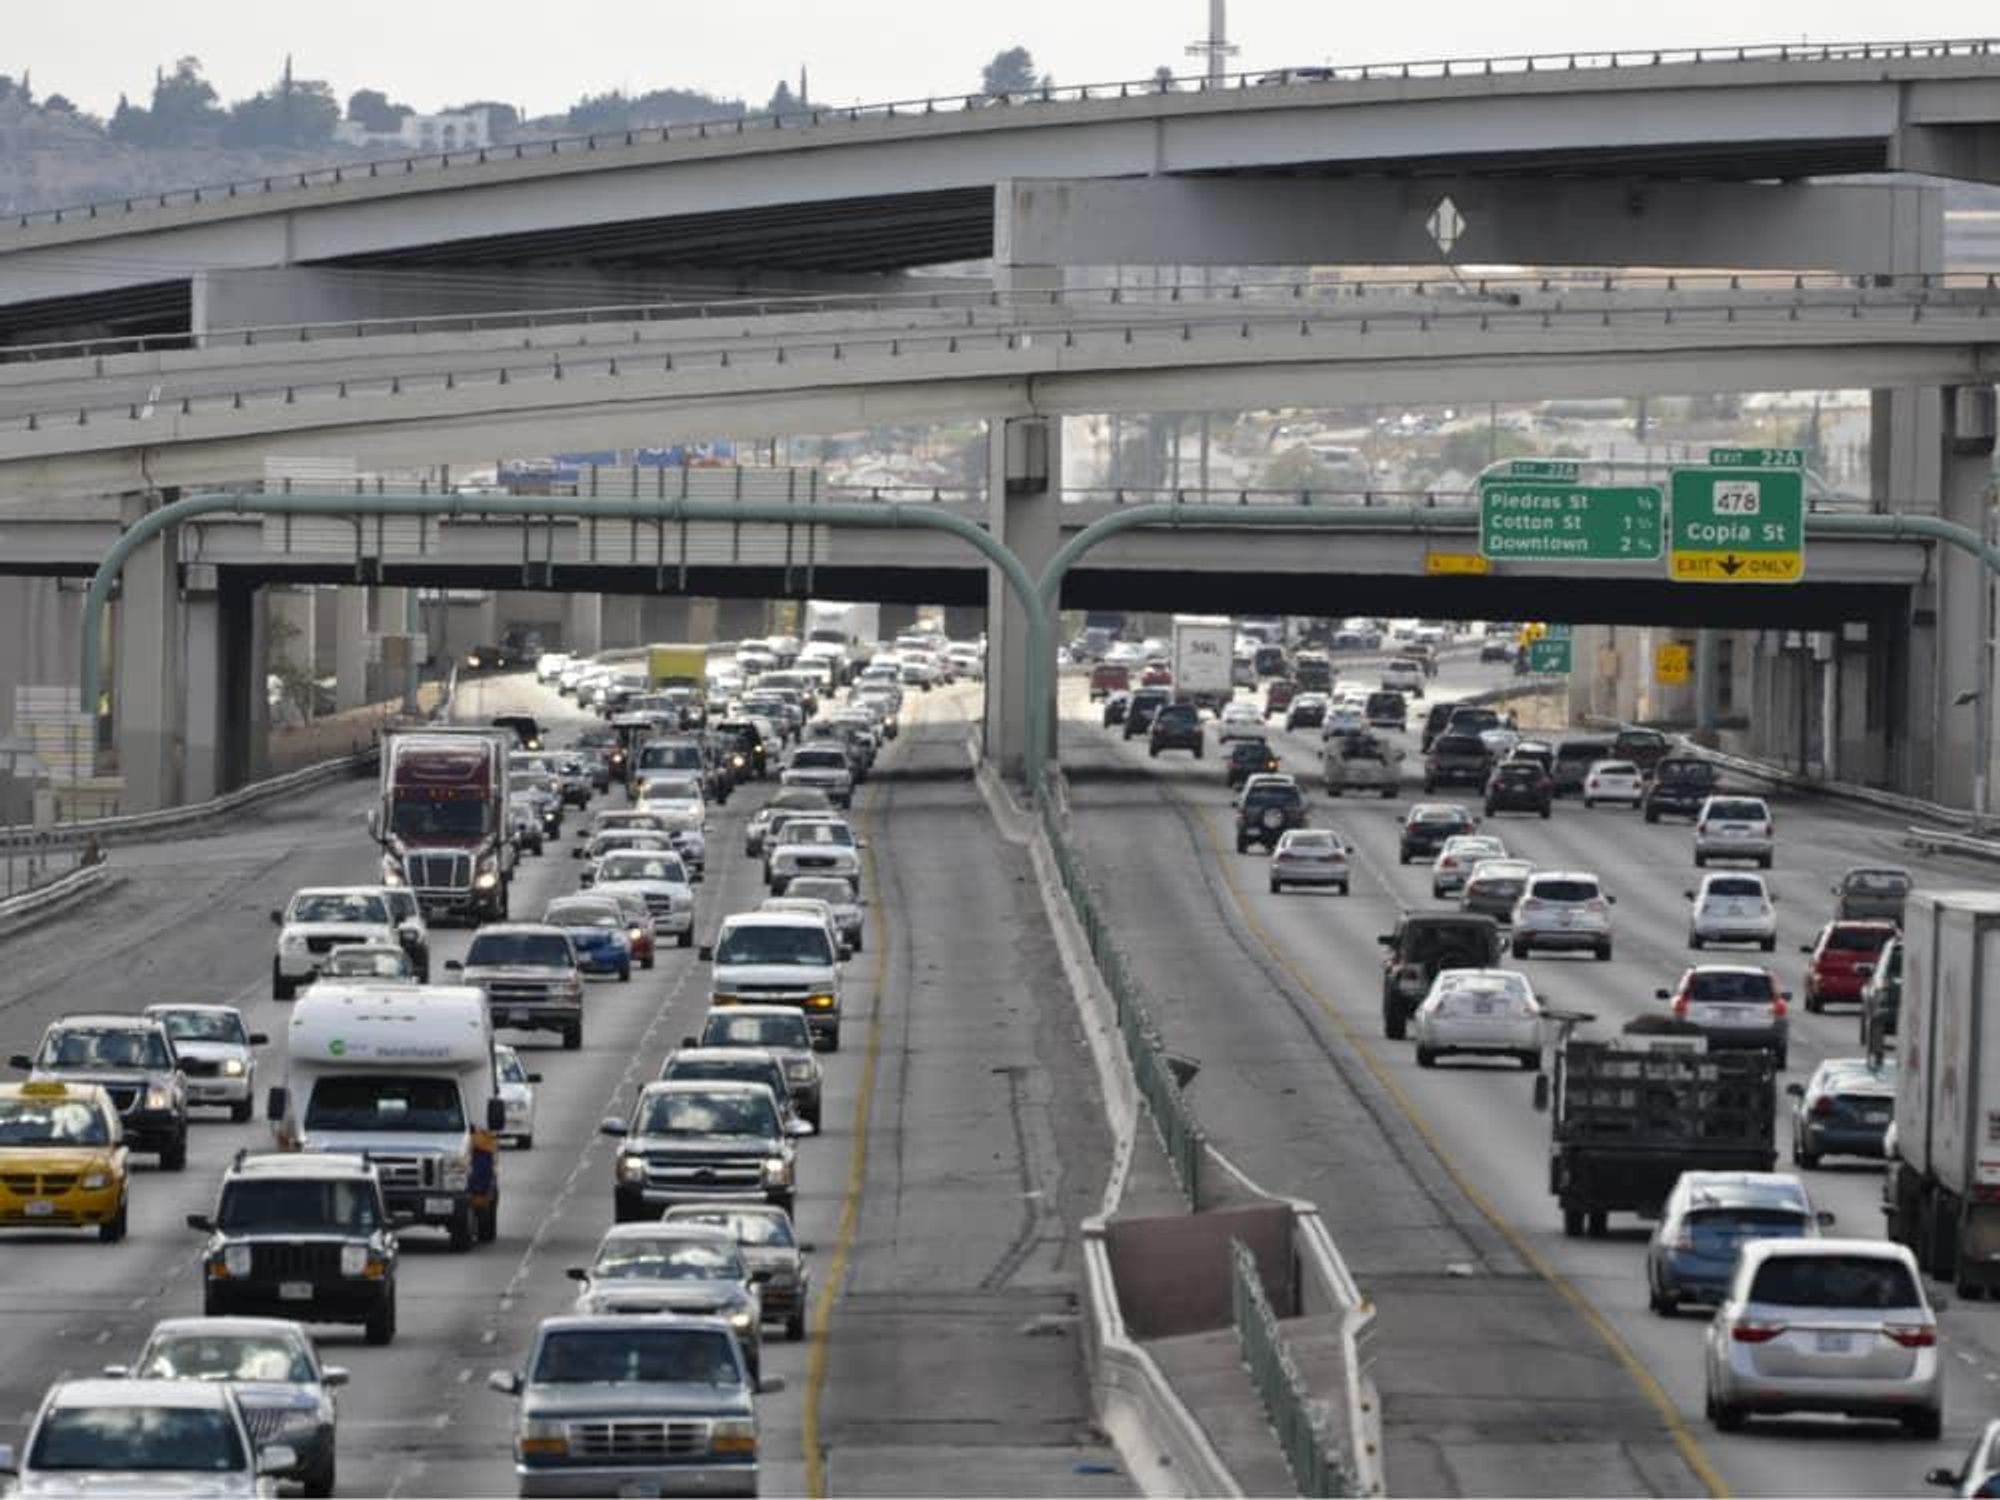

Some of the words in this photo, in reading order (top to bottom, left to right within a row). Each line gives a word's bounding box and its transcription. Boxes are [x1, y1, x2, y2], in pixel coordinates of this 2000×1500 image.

[1712, 451, 1743, 464] EXIT
[1760, 450, 1799, 465] 22A
[1491, 493, 1562, 509] Piedras
[1568, 494, 1589, 510] St
[1717, 493, 1757, 512] 478
[1490, 514, 1554, 530] Cotton
[1562, 514, 1583, 530] St
[1687, 522, 1752, 545] Copia
[1762, 523, 1786, 542] St
[1490, 535, 1589, 552] Downtown
[1620, 536, 1632, 552] 2
[1677, 559, 1713, 573] EXIT
[1748, 559, 1794, 573] ONLY
